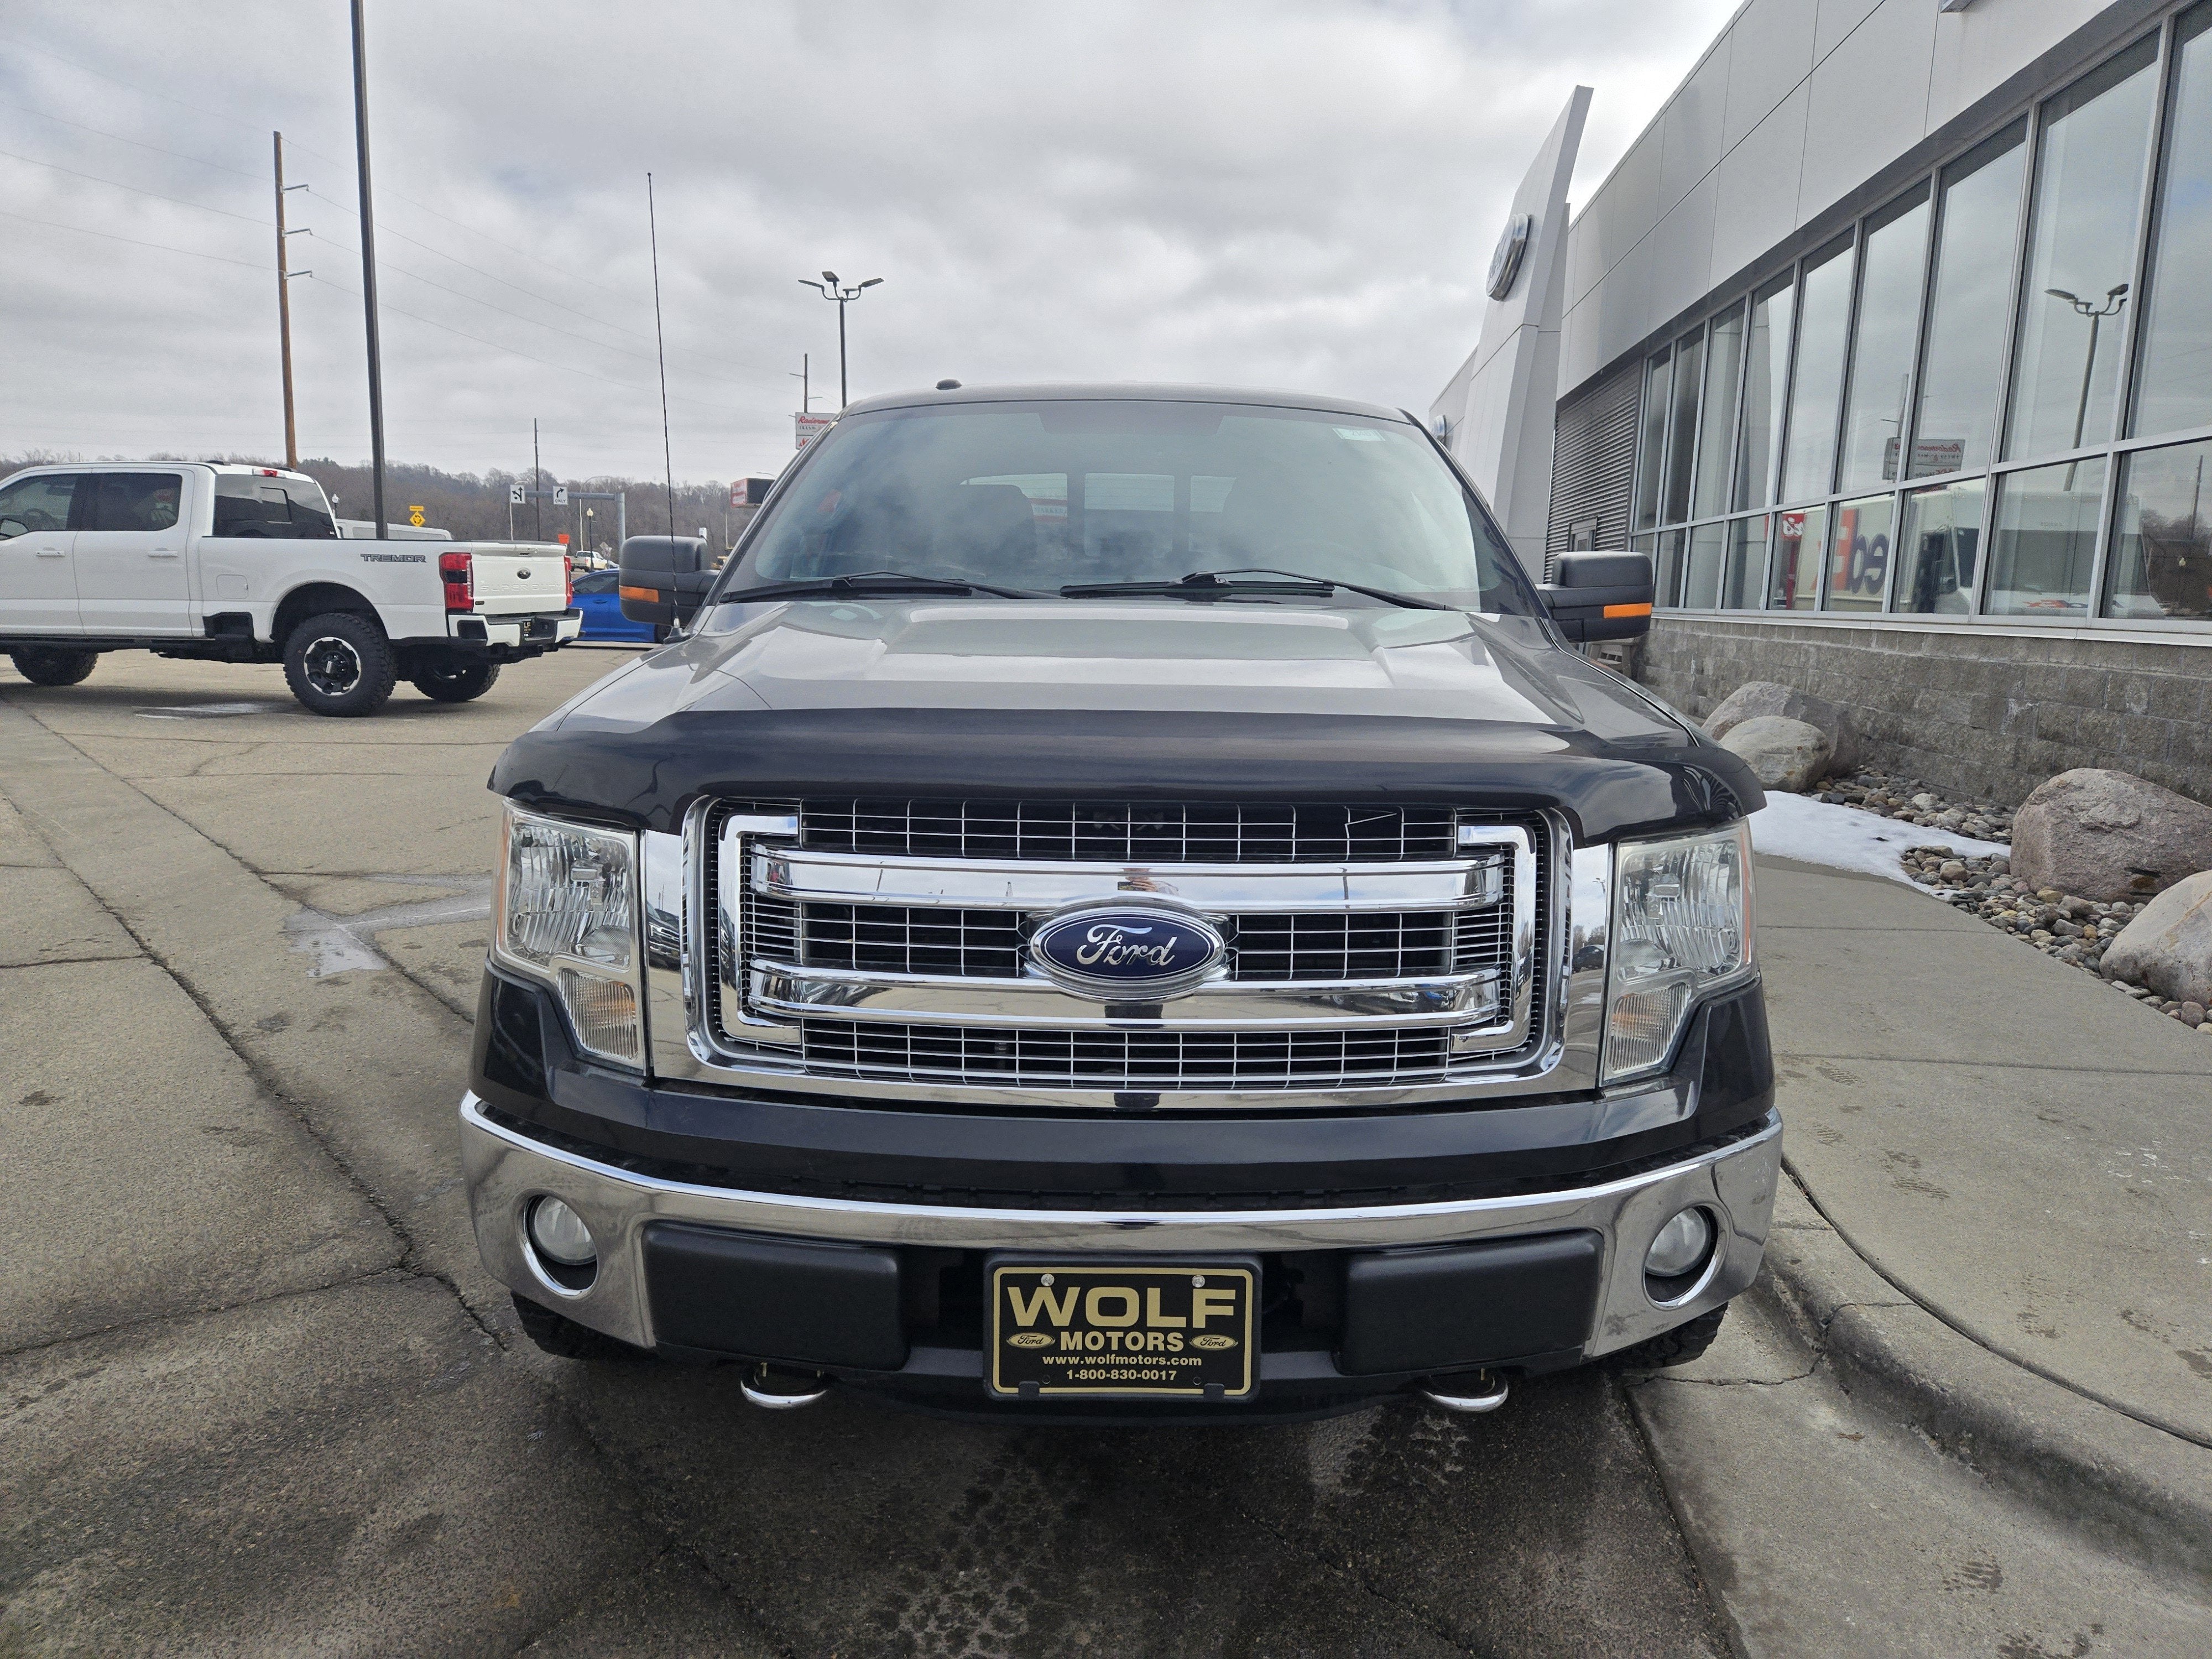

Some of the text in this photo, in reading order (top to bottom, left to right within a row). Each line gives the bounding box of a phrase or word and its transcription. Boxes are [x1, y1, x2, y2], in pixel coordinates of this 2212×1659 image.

[361, 554, 427, 563] TREMOR
[479, 583, 529, 592] SUPER
[1076, 924, 1178, 966] Ford
[1007, 1287, 1236, 1328] WOLF
[1017, 1335, 1044, 1344] Ford
[1060, 1331, 1184, 1352] MOTORS
[1199, 1337, 1227, 1347] Ford
[1042, 1354, 1202, 1366] www.wolfmotors.com
[1066, 1369, 1177, 1381] 1-800-830-0017
